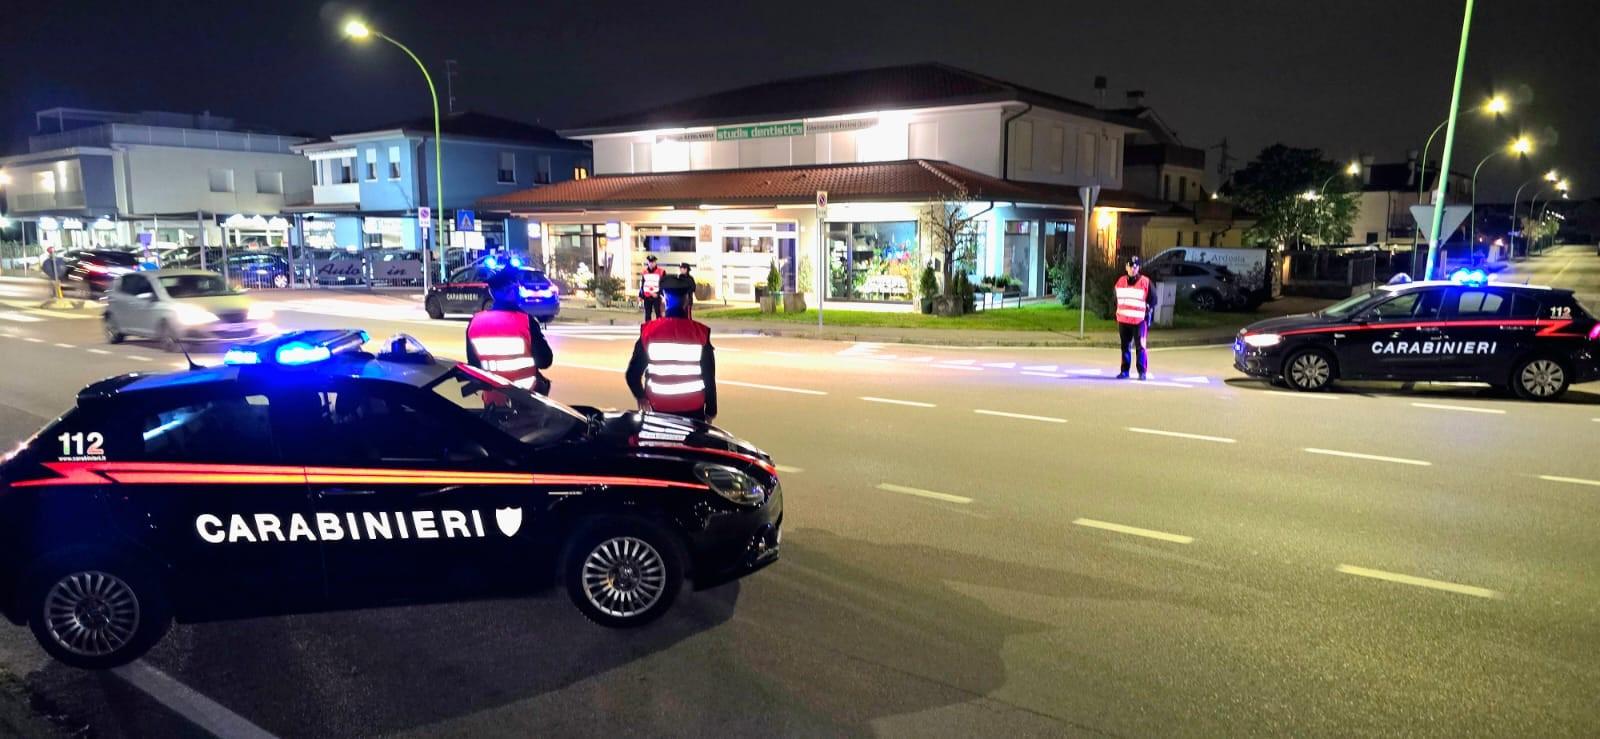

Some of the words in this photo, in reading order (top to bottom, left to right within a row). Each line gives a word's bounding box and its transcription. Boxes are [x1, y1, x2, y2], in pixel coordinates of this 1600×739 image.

[318, 263, 360, 276] Auto
[387, 266, 407, 276] in
[1550, 306, 1571, 317] 112
[1371, 341, 1497, 355] CARABINIERI
[58, 432, 104, 455] 112
[196, 509, 486, 543] CARABINIERI
